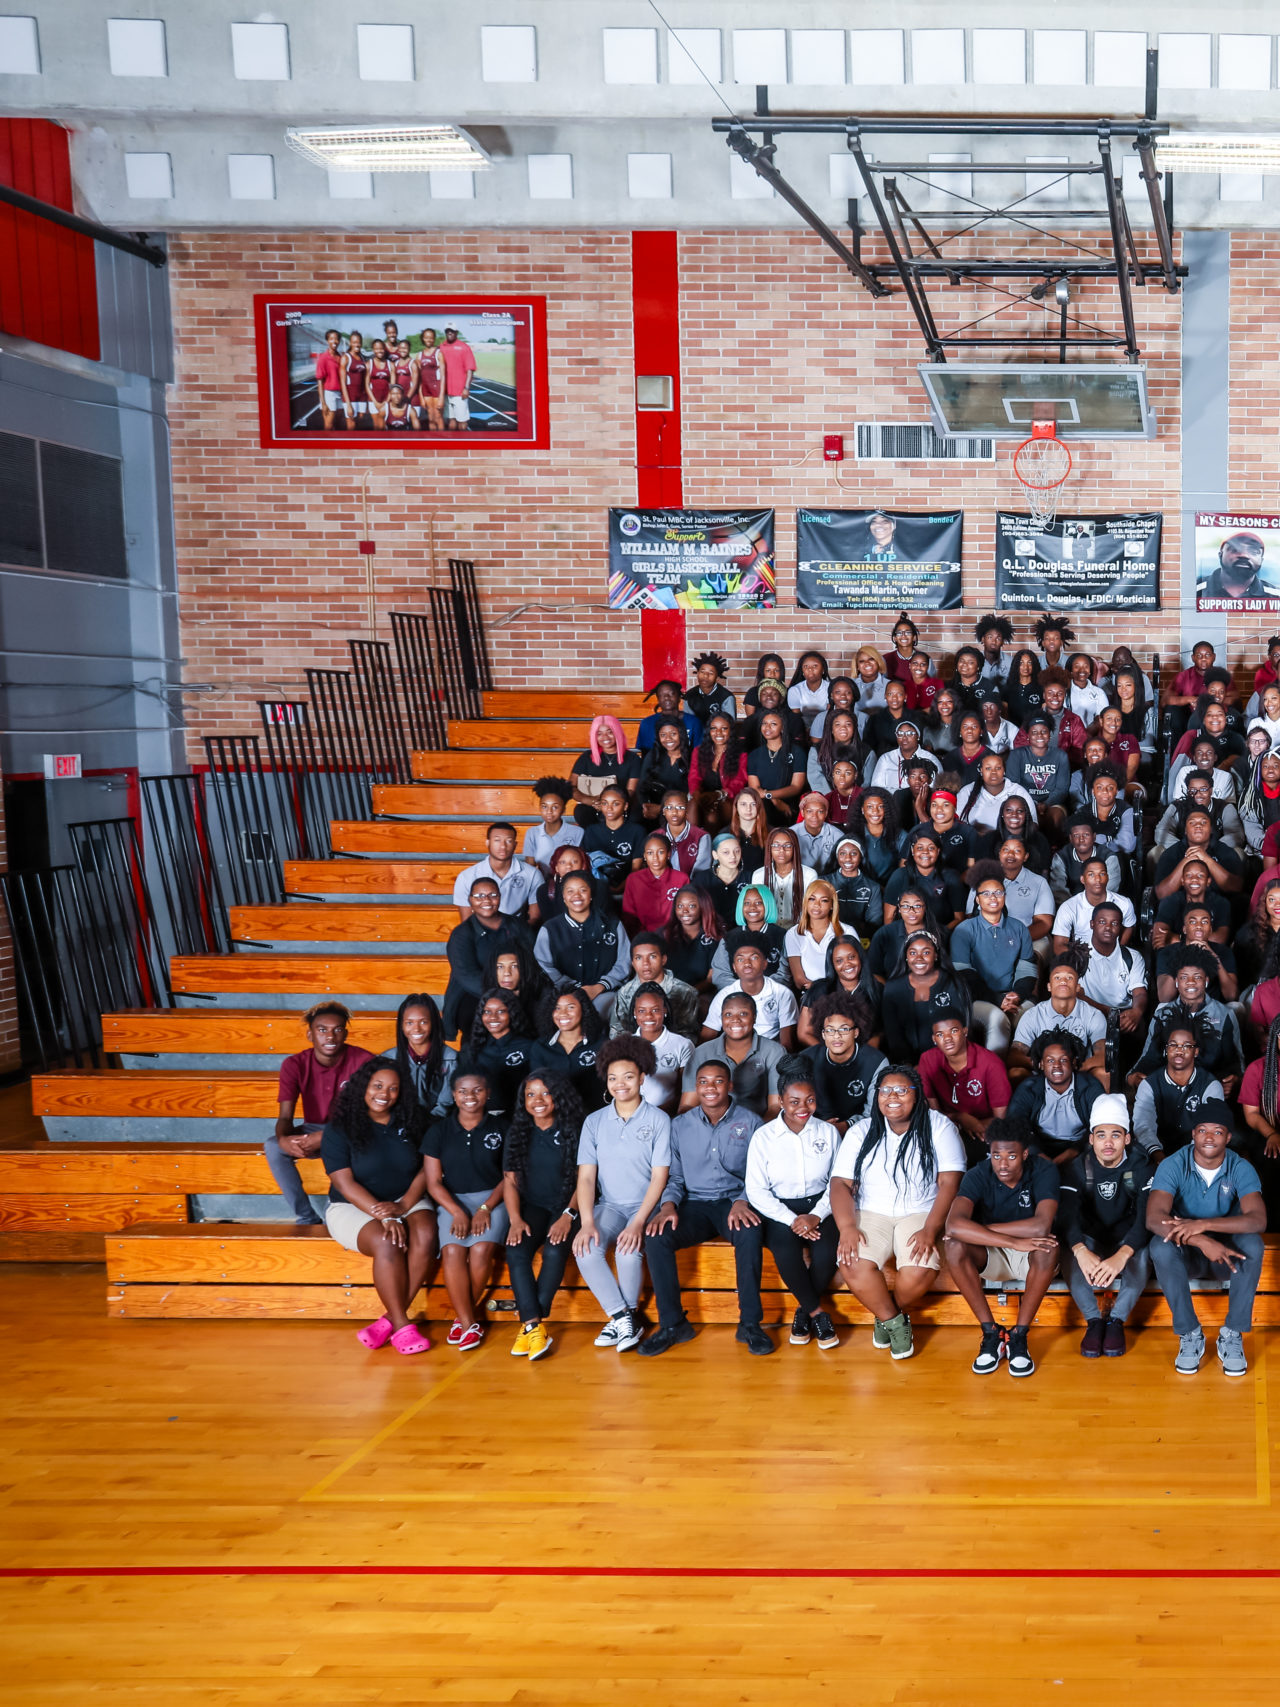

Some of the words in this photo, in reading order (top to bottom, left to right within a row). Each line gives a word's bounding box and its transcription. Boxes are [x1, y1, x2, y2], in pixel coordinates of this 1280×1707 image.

[668, 516, 685, 524] MBC
[694, 516, 737, 525] Jacksonville,
[802, 515, 832, 523] Licensed
[1105, 521, 1135, 529] Southside
[1136, 519, 1157, 529] Chapel
[1199, 516, 1216, 526] MY
[1218, 517, 1268, 527] SEASONS
[664, 529, 706, 542] Supports
[619, 542, 680, 556] WILLIAM
[684, 543, 698, 556] M.
[700, 543, 752, 556] RAINES
[863, 554, 871, 562] 1
[877, 554, 897, 562] UP
[632, 562, 666, 573] GIRLS
[666, 563, 741, 573] BASKETBALL
[819, 563, 883, 571] CLEANING
[887, 563, 942, 572] SERVICE
[1002, 559, 1024, 570] Q.L.
[1028, 560, 1073, 573] Douglas
[1077, 561, 1119, 571] Funeral
[1122, 561, 1156, 571] Home
[646, 573, 681, 584] TEAM
[1059, 572, 1085, 580] Serving
[1087, 572, 1120, 580] Deserving
[913, 580, 945, 588] Cleaning
[833, 585, 870, 595] Tawanda
[871, 586, 900, 596] Martin,
[902, 586, 928, 595] Owner
[1001, 593, 1034, 603] Quinton
[1037, 594, 1045, 603] L.
[1047, 594, 1084, 605] Douglas,
[1115, 595, 1156, 604] Mortician
[1198, 600, 1243, 610] SUPPORTS
[1245, 600, 1267, 610] LADY
[56, 756, 77, 777] EXIT
[1024, 763, 1056, 774] RAINES
